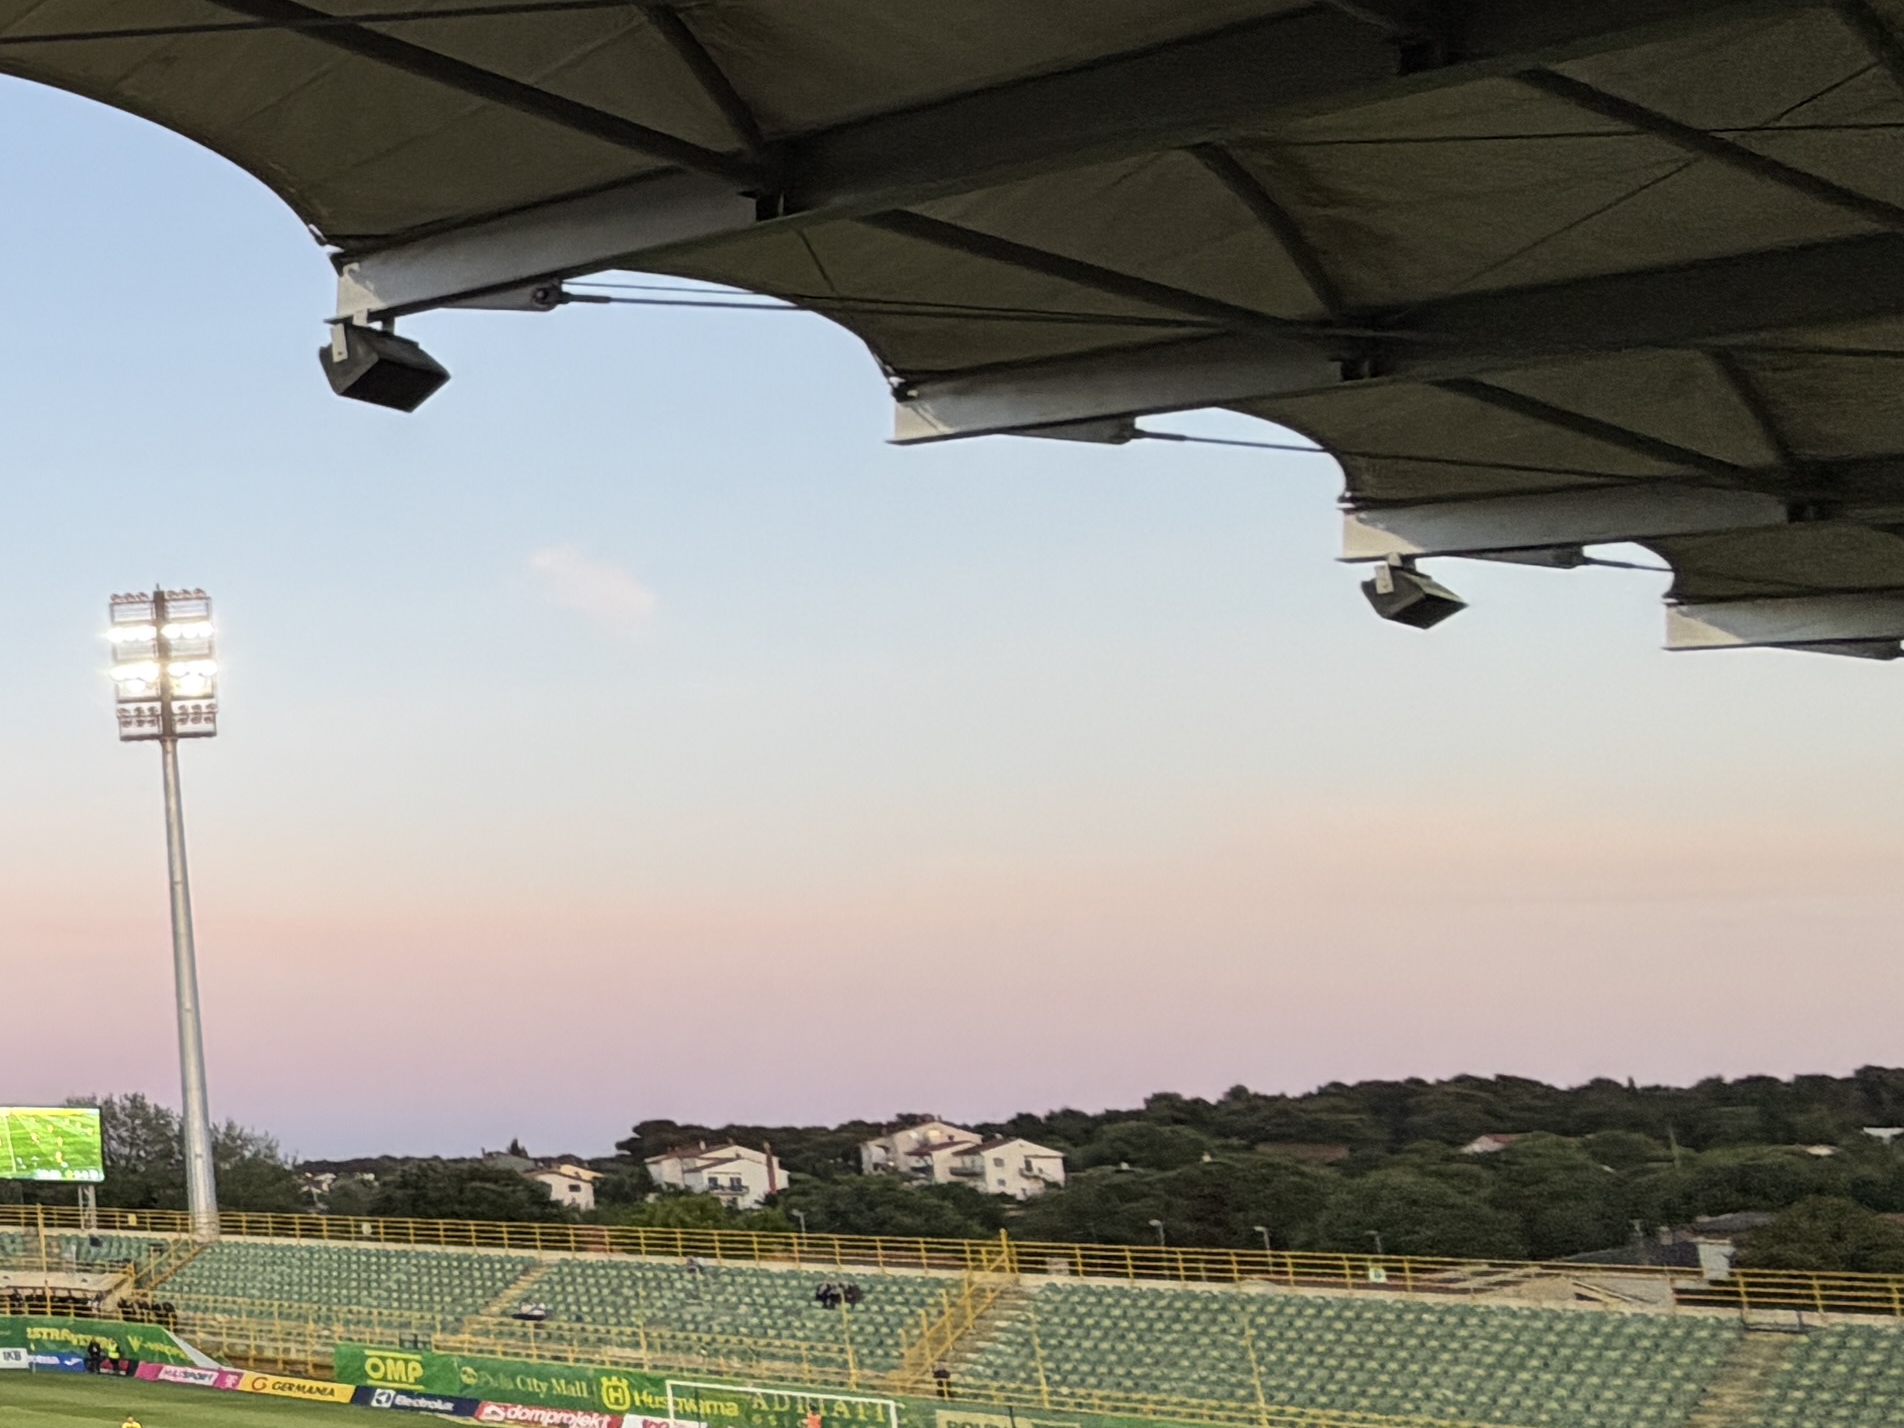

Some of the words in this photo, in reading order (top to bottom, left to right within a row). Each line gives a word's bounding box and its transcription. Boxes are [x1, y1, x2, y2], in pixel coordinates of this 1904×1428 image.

[364, 1355, 424, 1383] OMP
[271, 1380, 336, 1398] GERMANIA
[515, 1374, 549, 1398] City
[550, 1377, 591, 1399] Mall
